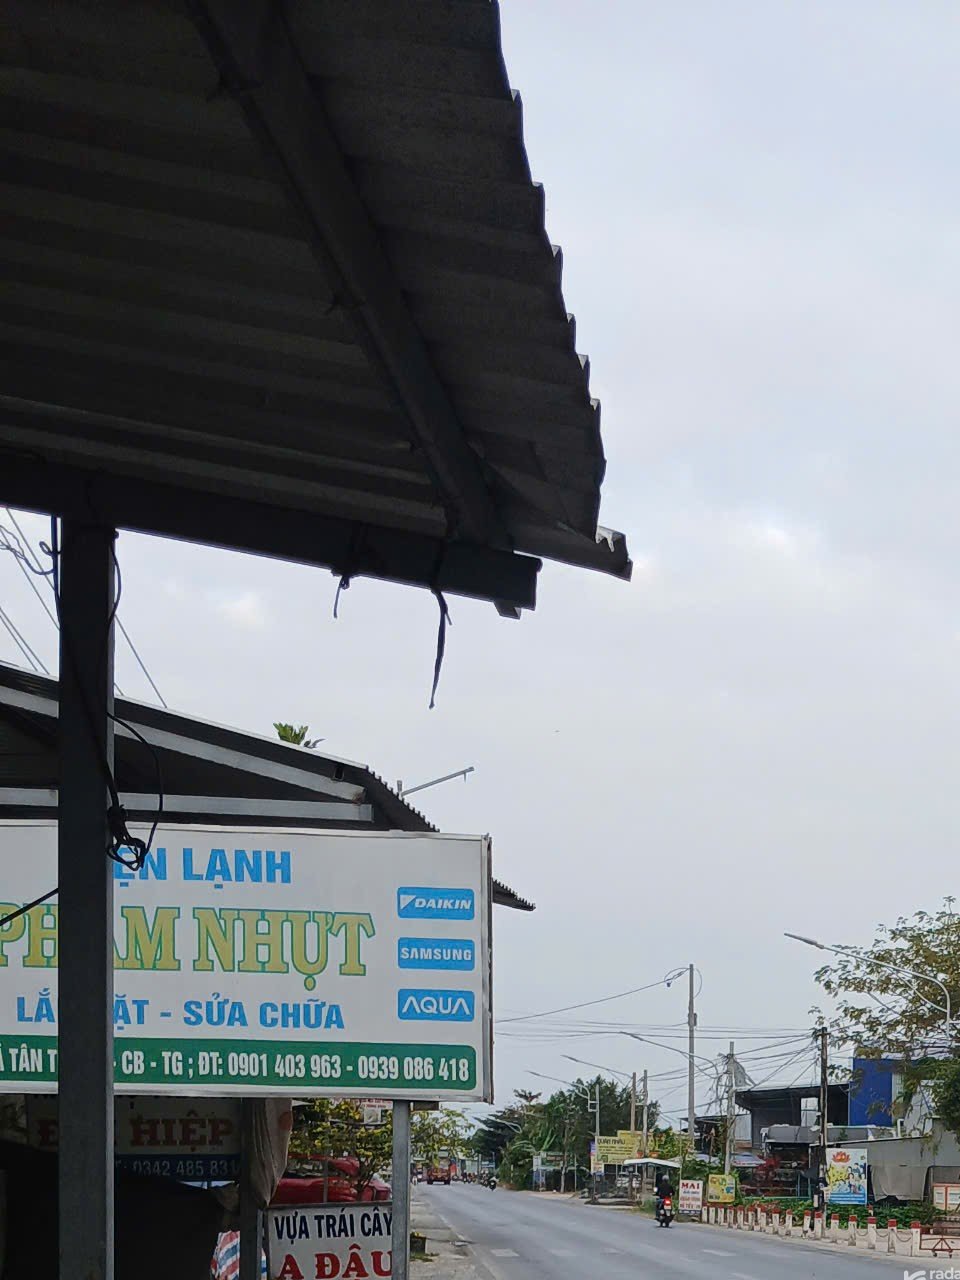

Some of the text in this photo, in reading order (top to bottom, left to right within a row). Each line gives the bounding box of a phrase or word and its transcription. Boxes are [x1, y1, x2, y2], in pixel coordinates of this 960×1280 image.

[183, 848, 291, 889] LẠNH
[415, 898, 472, 910] DAIKIN
[0, 903, 376, 991] PHM NHỰT
[401, 947, 473, 961] SAMSUNG
[16, 987, 56, 1022] LẮ
[113, 994, 149, 1030] ẶT
[183, 992, 248, 1027] SỬA
[259, 998, 345, 1030] CHỮA
[401, 996, 471, 1015] AQUA
[8, 1043, 43, 1073] TÂN
[121, 1050, 145, 1075] CB
[161, 1051, 184, 1076] TG
[198, 1051, 223, 1076] ĐT:
[228, 1052, 268, 1077] 0901
[274, 1053, 306, 1078] 403
[310, 1055, 342, 1078] 963
[358, 1055, 399, 1080] 0939
[403, 1056, 434, 1080] 086
[438, 1058, 470, 1082] 418
[130, 1109, 235, 1152] HIỆP
[176, 1160, 204, 1176] 485
[681, 1182, 700, 1190] MAI
[274, 1206, 392, 1245] VỰA TRÁI CÂY
